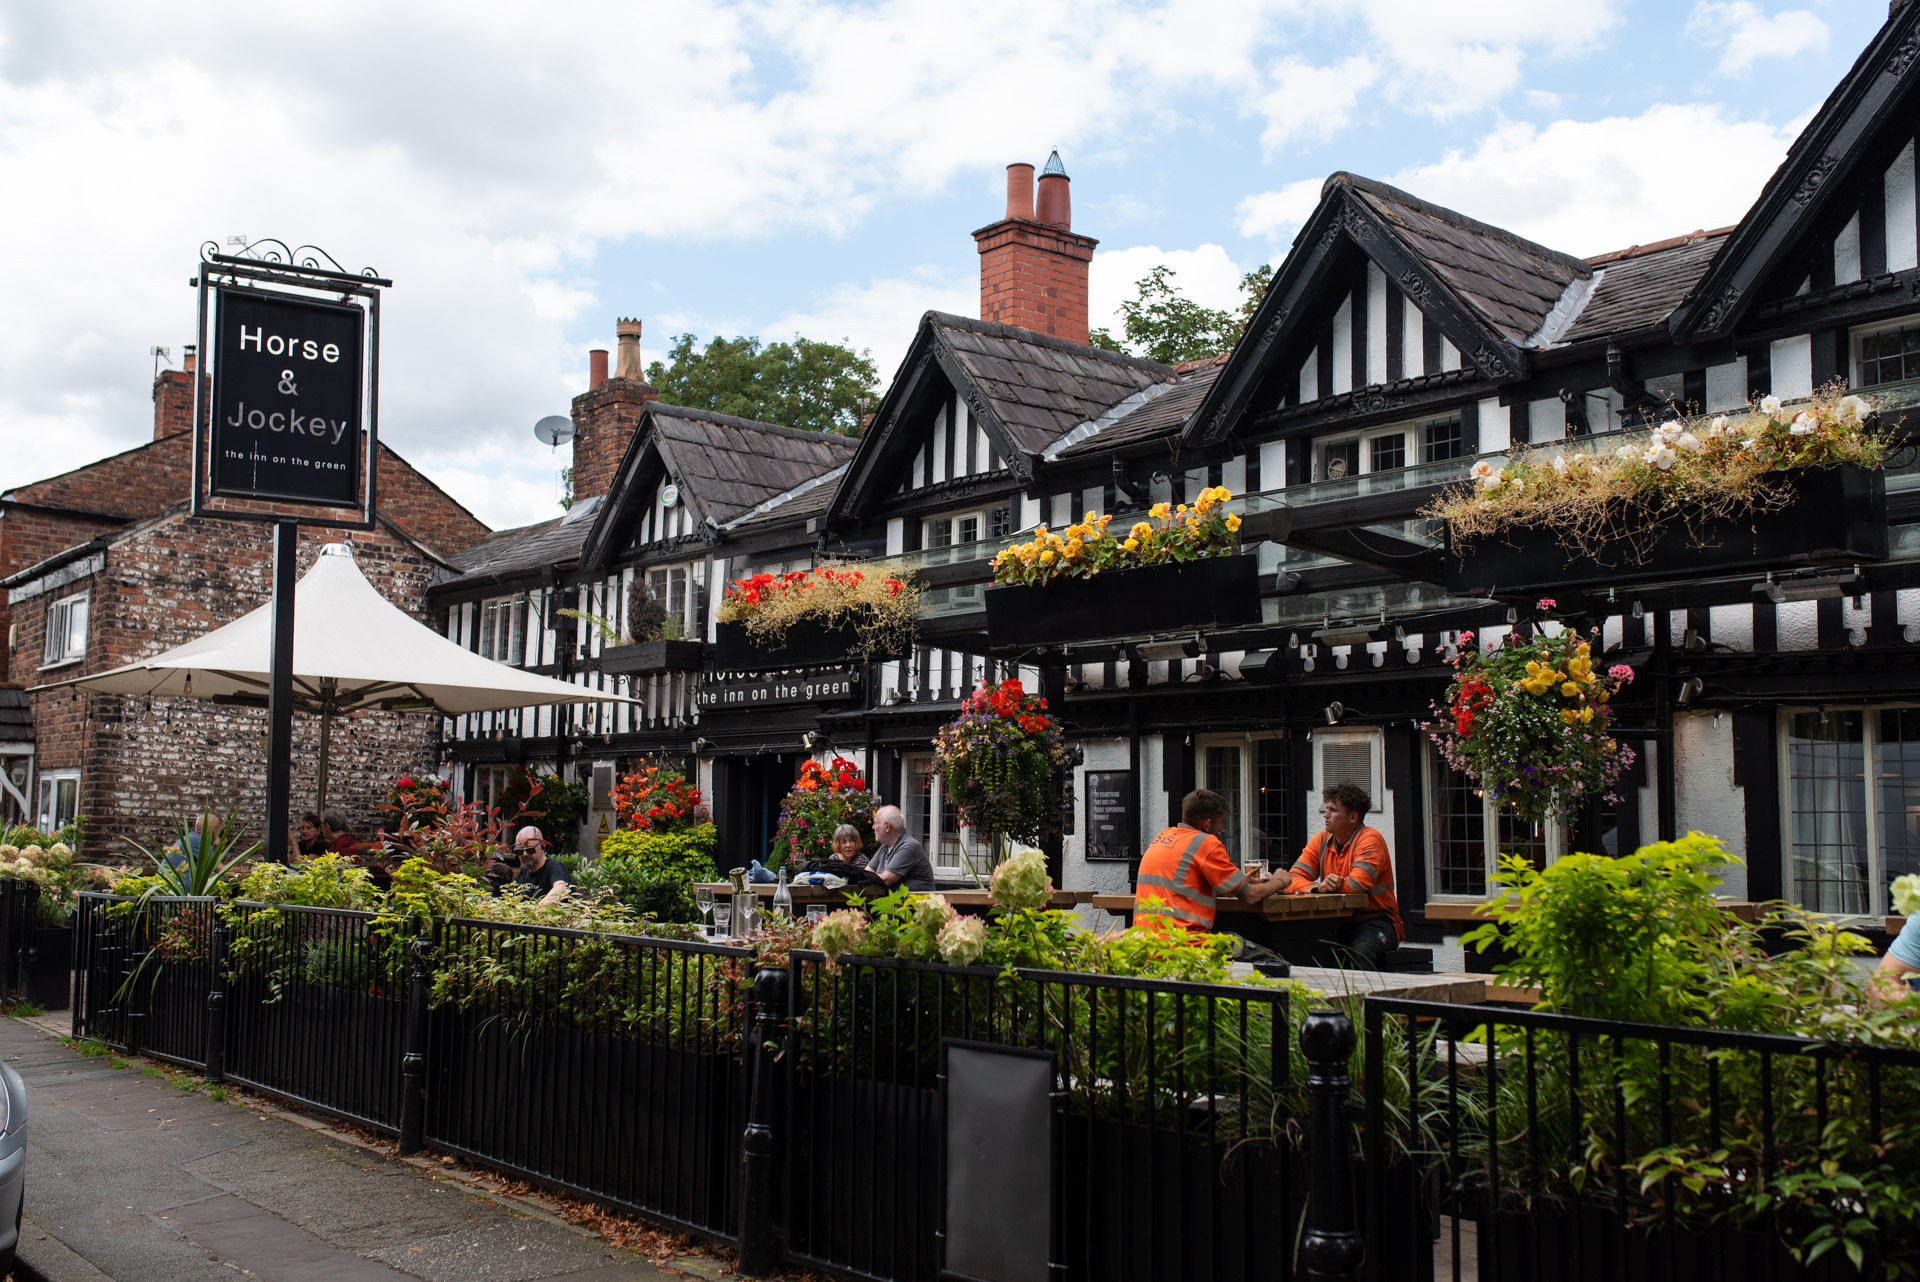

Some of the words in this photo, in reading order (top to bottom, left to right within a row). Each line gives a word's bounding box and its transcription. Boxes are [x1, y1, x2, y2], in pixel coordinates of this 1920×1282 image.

[240, 324, 340, 363] Horse
[277, 369, 299, 396] &
[227, 402, 347, 445] Jockey
[225, 450, 244, 459] the
[249, 452, 267, 462] inn
[272, 456, 286, 464] on
[291, 457, 309, 467] the
[314, 461, 346, 471] green
[697, 692, 717, 705] the
[724, 689, 744, 703] inn
[752, 688, 767, 701] on
[775, 684, 797, 699] the
[806, 681, 850, 700] green
